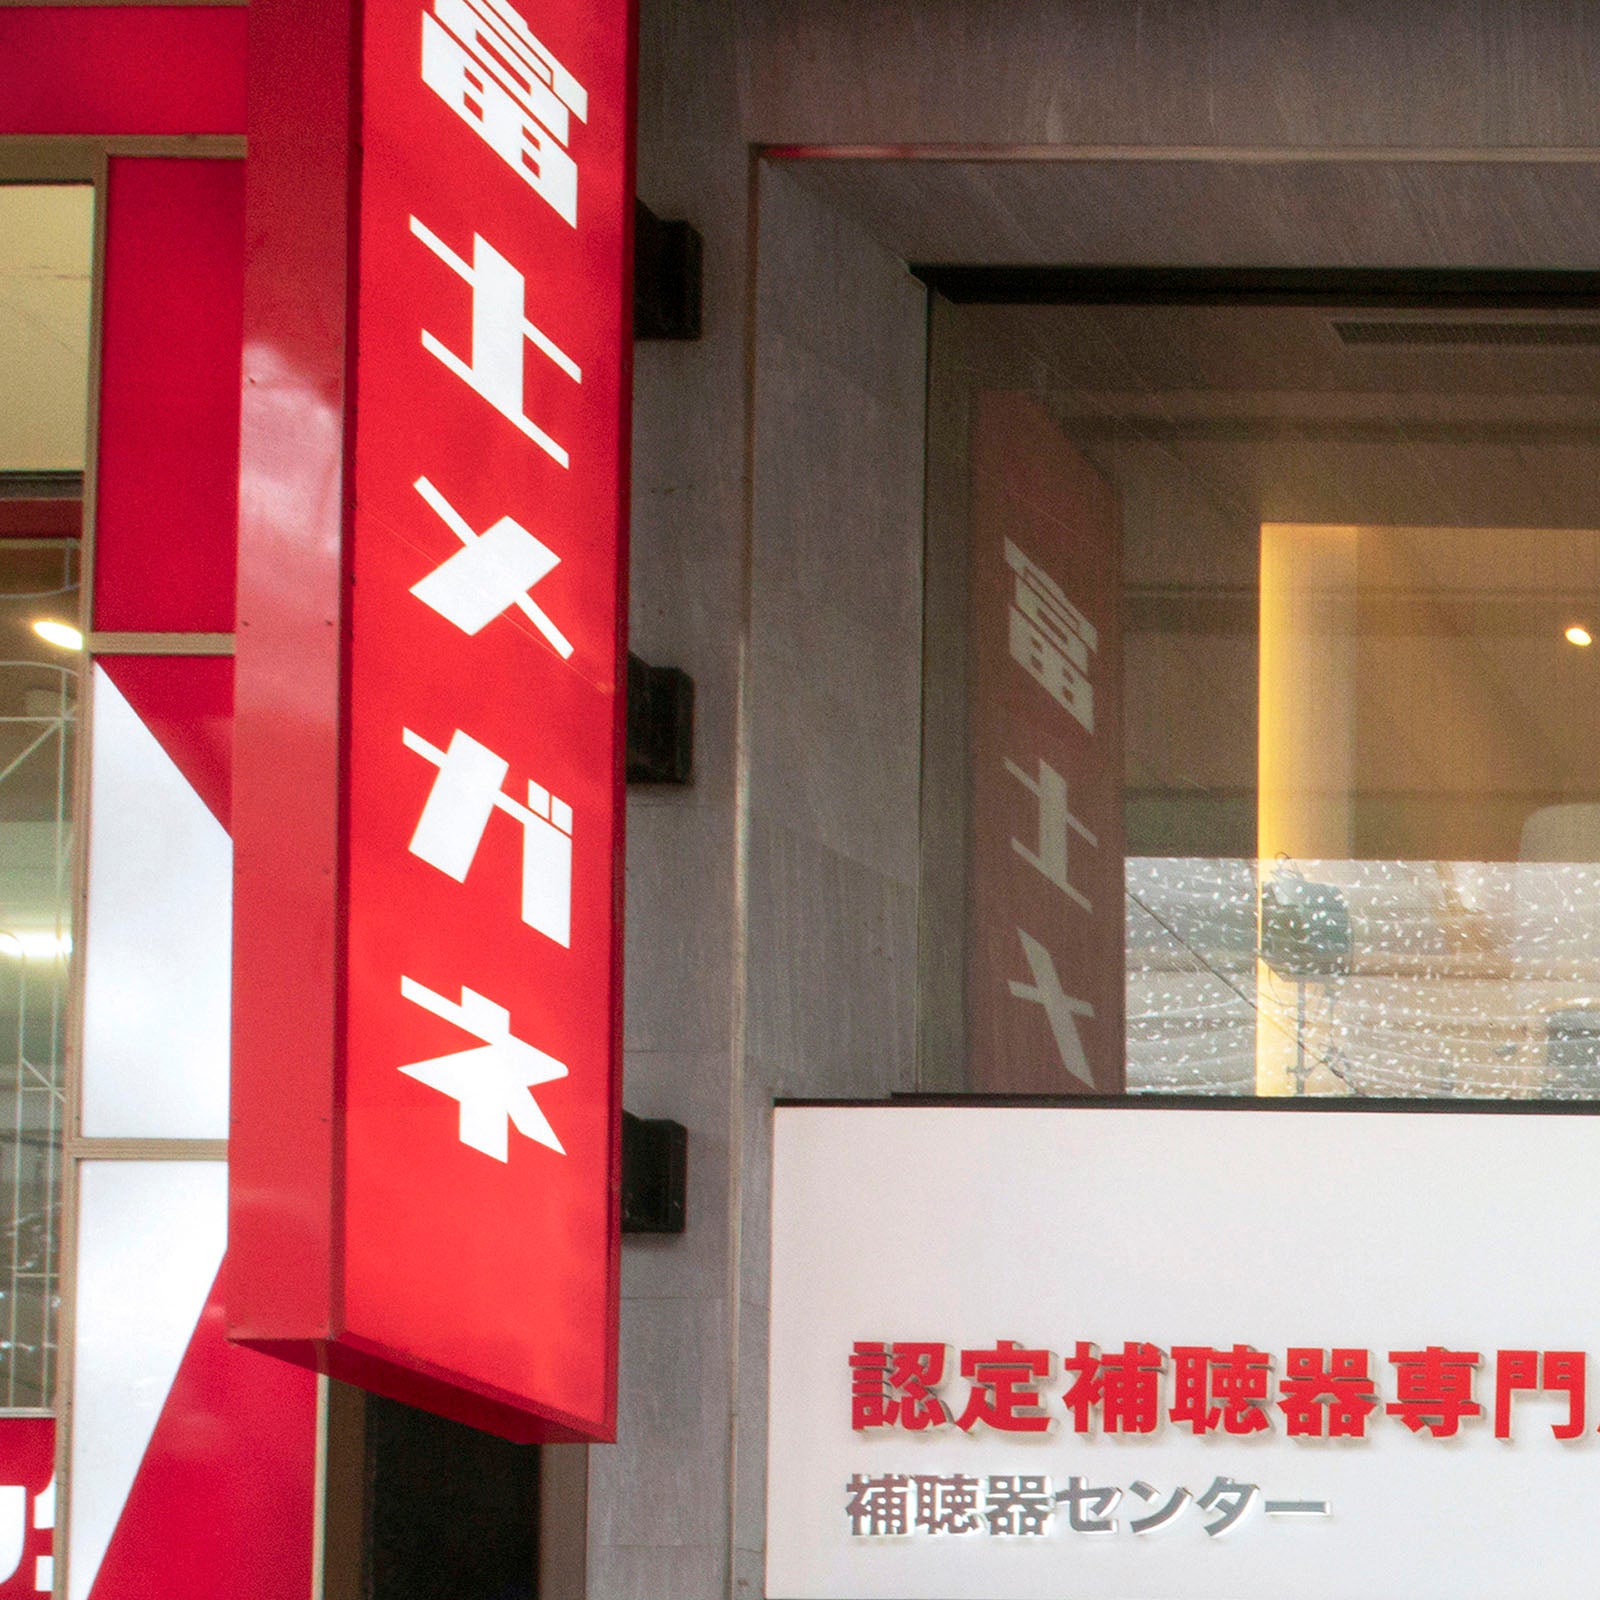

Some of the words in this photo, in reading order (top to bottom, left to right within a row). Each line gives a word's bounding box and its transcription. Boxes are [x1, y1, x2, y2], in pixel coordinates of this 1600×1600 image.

[397, 0, 588, 1164] 富士メガネ
[846, 1475, 1332, 1538] 補聴器センター
